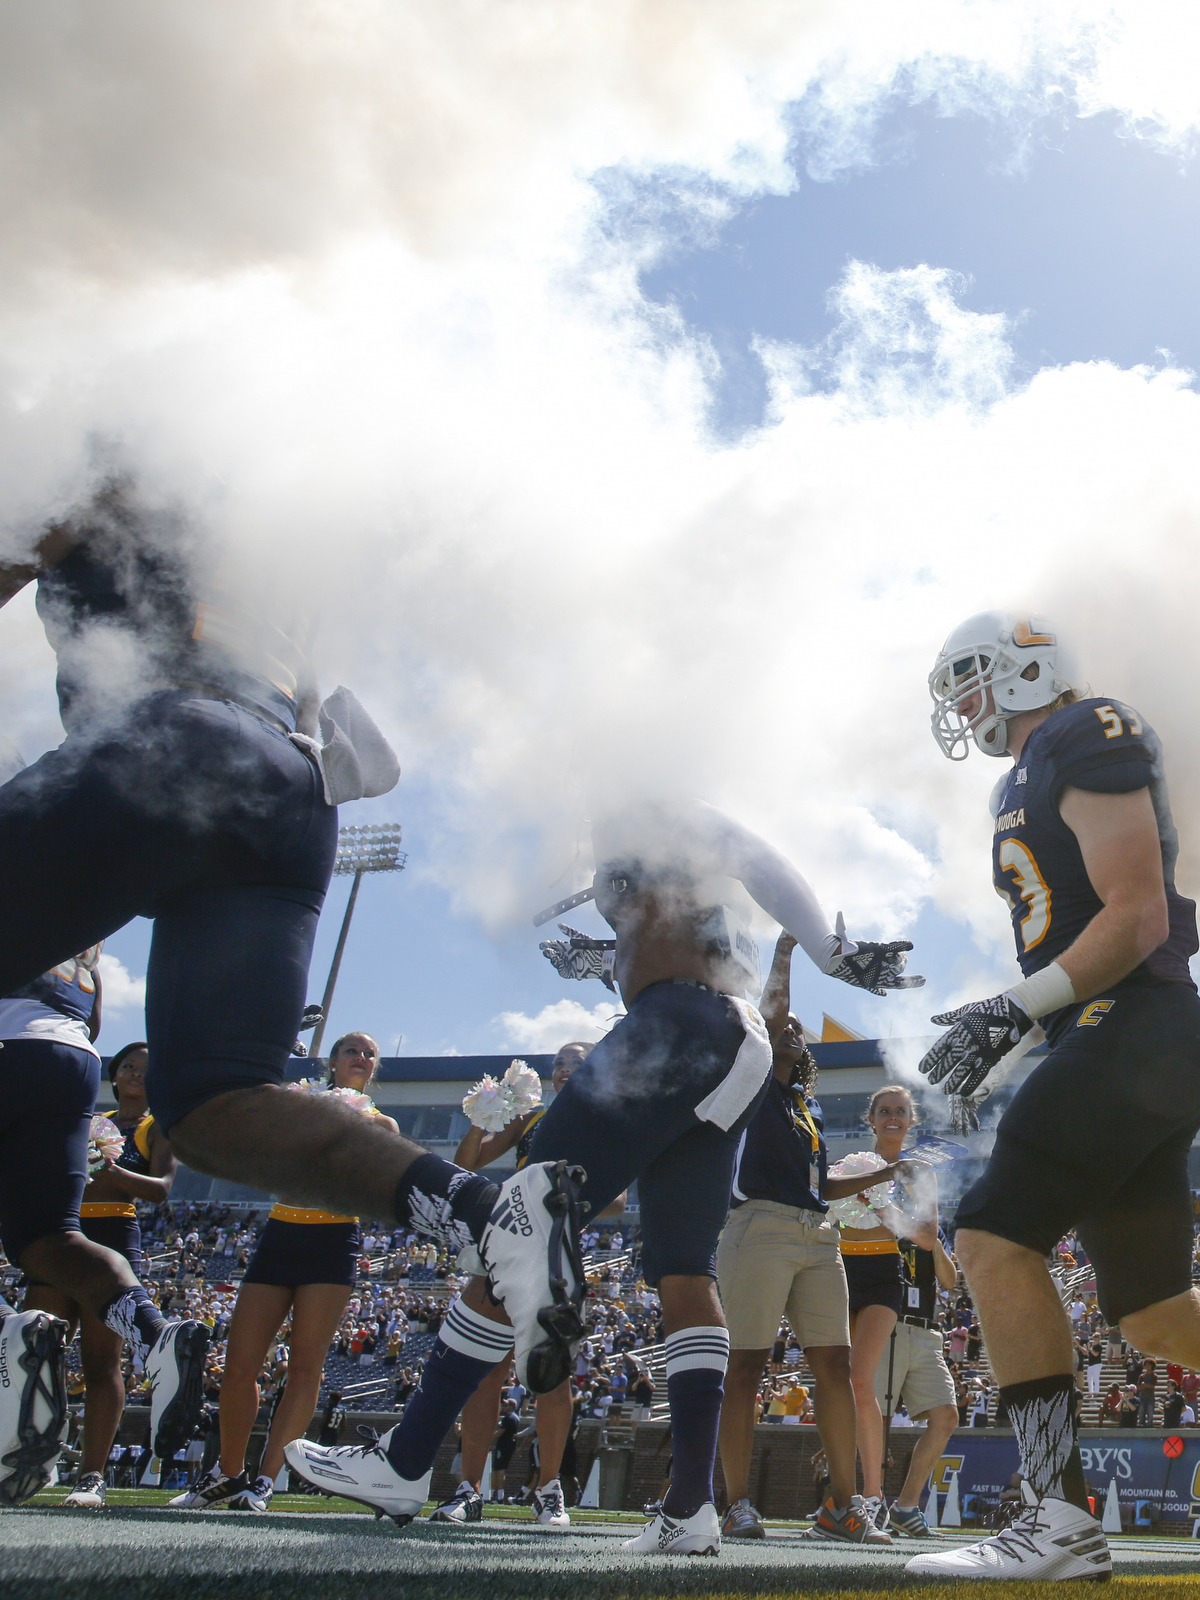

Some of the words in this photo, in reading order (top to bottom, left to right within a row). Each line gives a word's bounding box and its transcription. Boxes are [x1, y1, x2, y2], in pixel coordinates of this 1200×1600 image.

[1094, 704, 1144, 739] 53
[1077, 1000, 1116, 1027] C
[991, 1026, 1009, 1048] adidas
[511, 1185, 533, 1236] adidas
[328, 1412, 342, 1428] 33
[1120, 1488, 1163, 1497] MOUNTAIN
[1165, 1490, 1178, 1498] RD.
[658, 1526, 687, 1549] adidas
